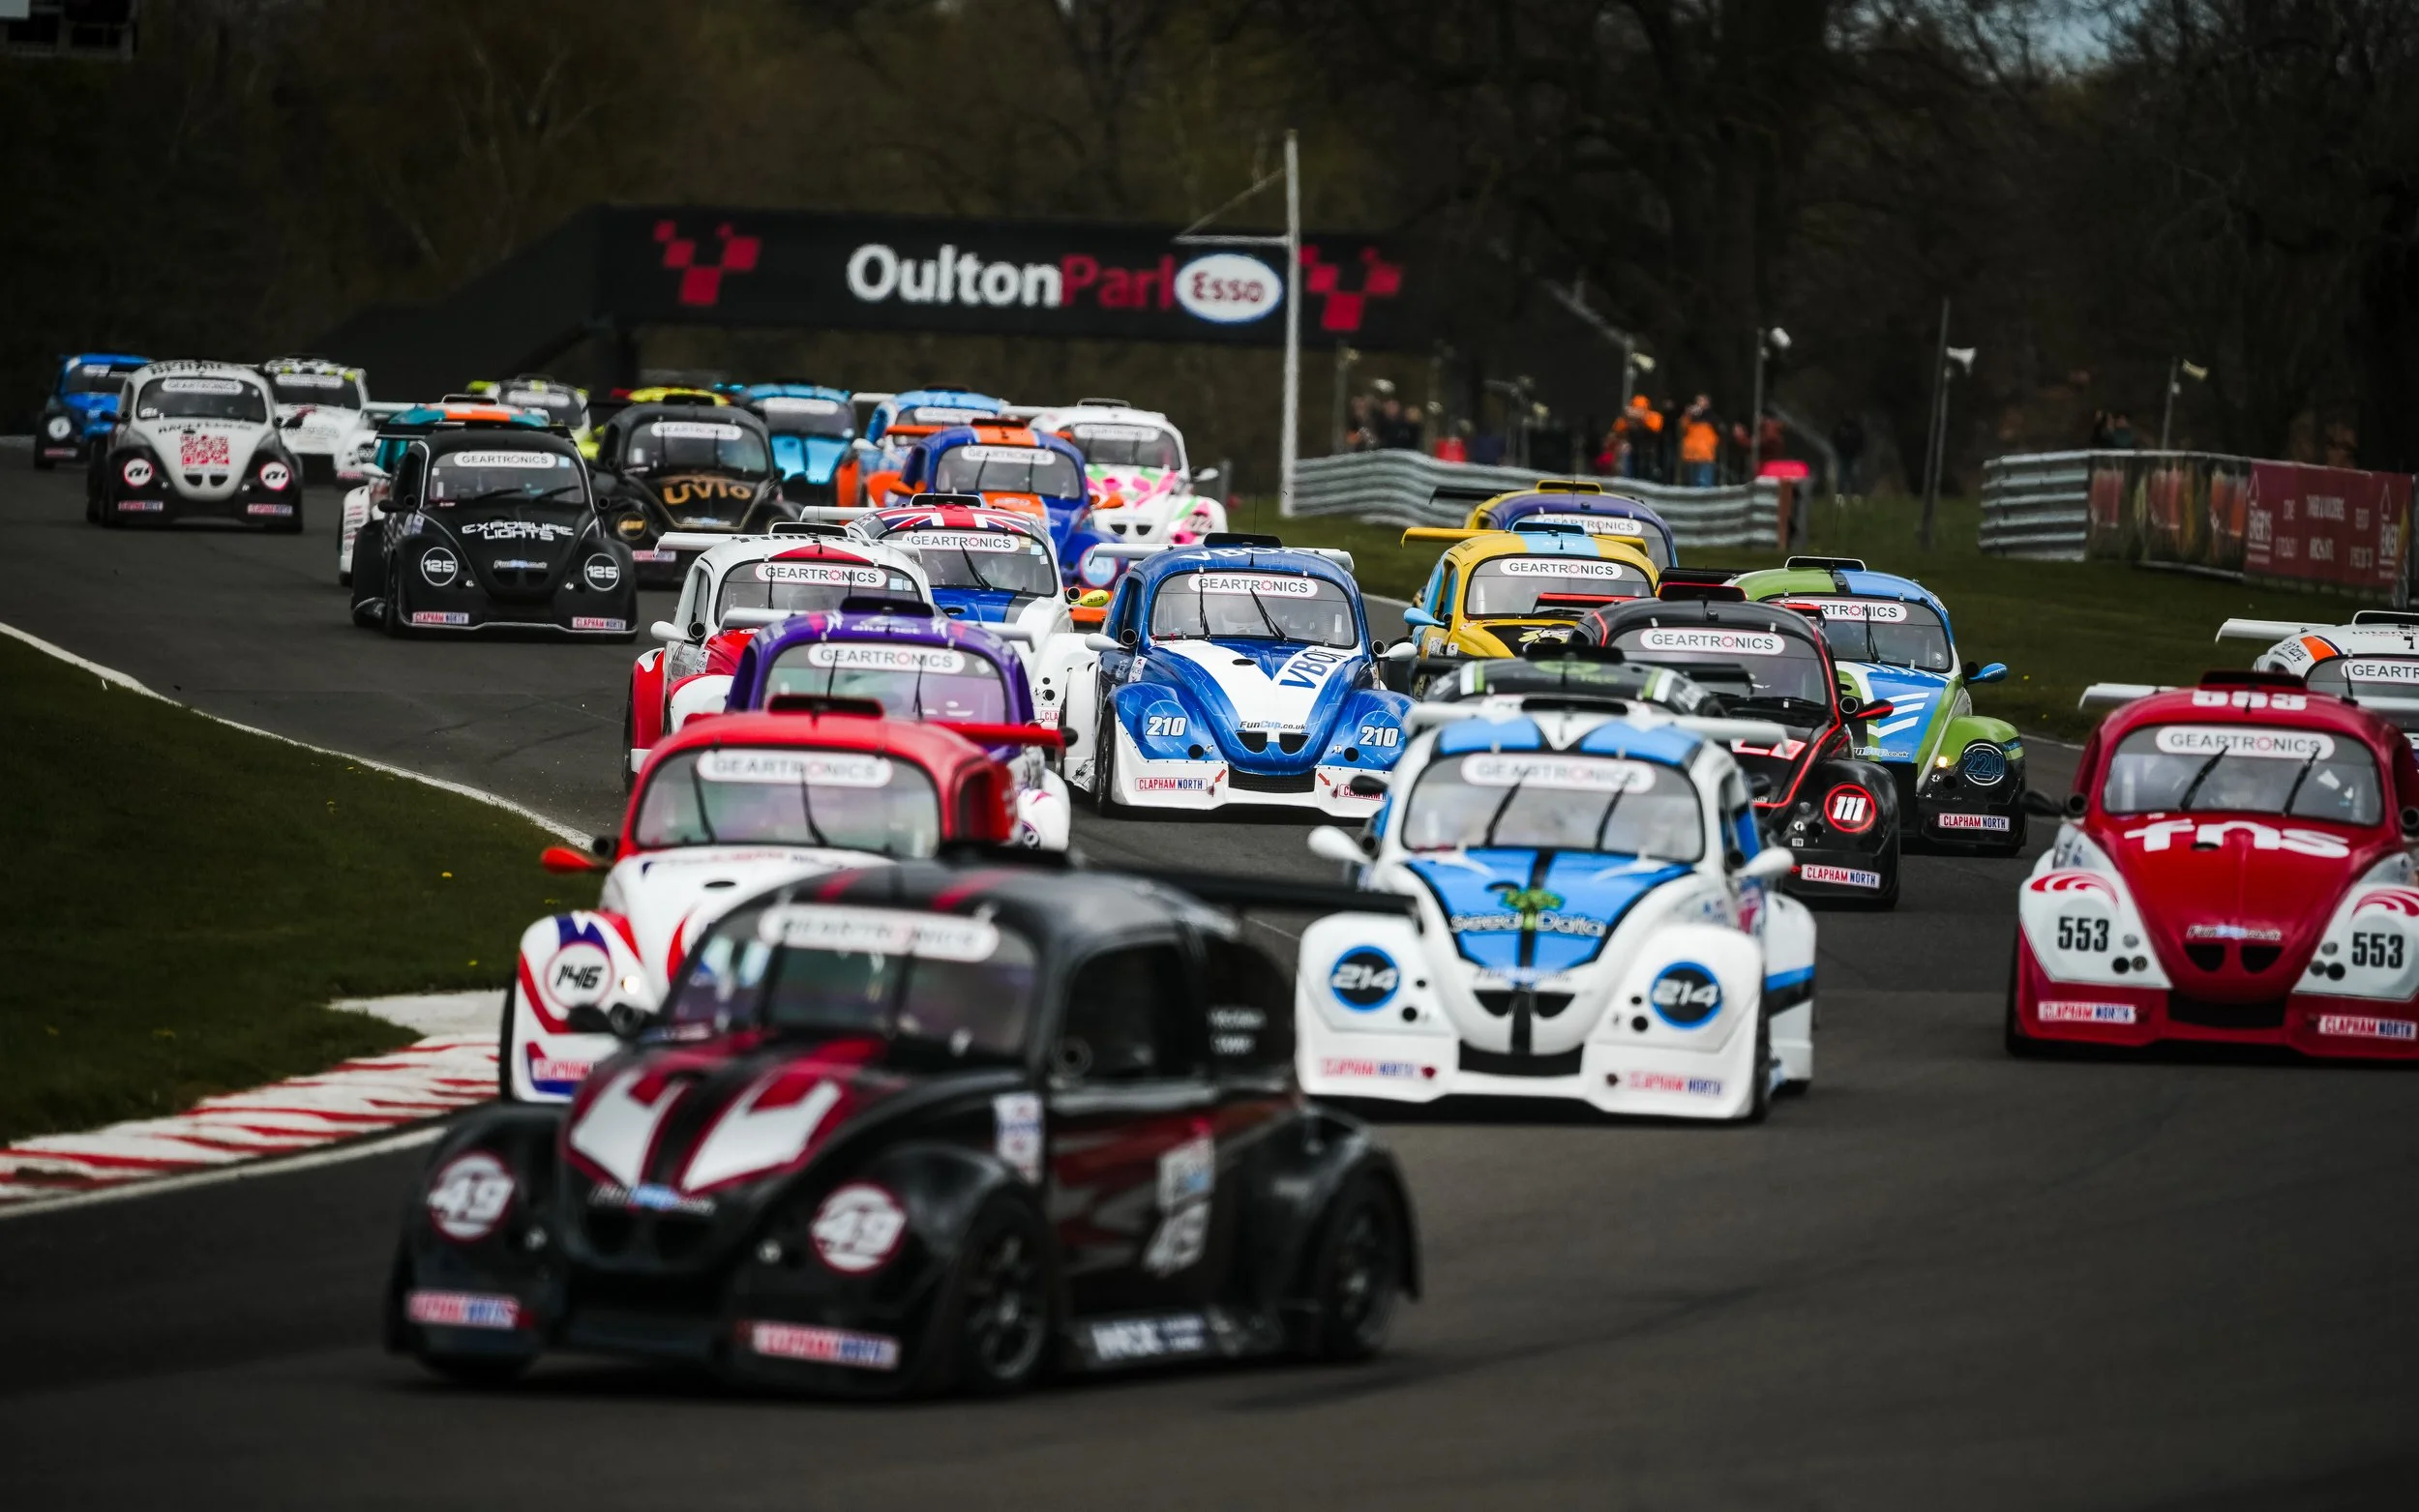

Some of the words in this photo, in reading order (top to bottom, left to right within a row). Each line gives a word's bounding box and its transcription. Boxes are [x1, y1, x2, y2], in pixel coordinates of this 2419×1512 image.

[1191, 272, 1265, 302] Esso
[462, 455, 549, 464] GEARTRONICS
[969, 448, 1048, 461] GEARTRONICS
[462, 520, 575, 536] EXPOSURE
[484, 528, 554, 542] LIGHTS
[911, 534, 1012, 549] GEARTRONICS
[424, 559, 454, 573] 125
[586, 565, 617, 579] 125
[764, 566, 878, 583] GEARTRONICS
[1508, 562, 1614, 577] GEARTRONICS
[1198, 578, 1308, 594] GEARTRONICS
[1819, 604, 1897, 618] RTRONICS
[576, 617, 604, 628] CLAPHAM
[1651, 634, 1775, 650] GEARTRONICS
[820, 648, 953, 667] GEARTRONICS
[1279, 649, 1349, 690] VBOX
[1146, 716, 1187, 737] 210
[1239, 720, 1306, 731] FunCup.co.uk
[1359, 726, 1399, 748] 210
[2170, 732, 2322, 755] GEARTRONICS
[713, 756, 879, 780] GEARTRONICS
[1963, 752, 2005, 777] 220
[1138, 778, 1177, 790] CLAPHAM
[1178, 778, 1205, 791] NORTH
[1832, 795, 1867, 822] 111
[1943, 815, 1981, 828] CLAPHAM
[1982, 816, 2006, 829] NORTH
[1807, 867, 1848, 883] CLAPHAM
[1849, 873, 1876, 886] NORTH
[2057, 916, 2109, 953] 553
[2351, 932, 2404, 970] 553
[555, 964, 604, 991] 146
[1330, 963, 1400, 992] 214
[1653, 978, 1720, 1008] 214
[2325, 1017, 2376, 1033] CLAPHAM
[2378, 1022, 2413, 1038] NORTH
[427, 1173, 516, 1221] 49
[812, 1206, 907, 1259] 49
